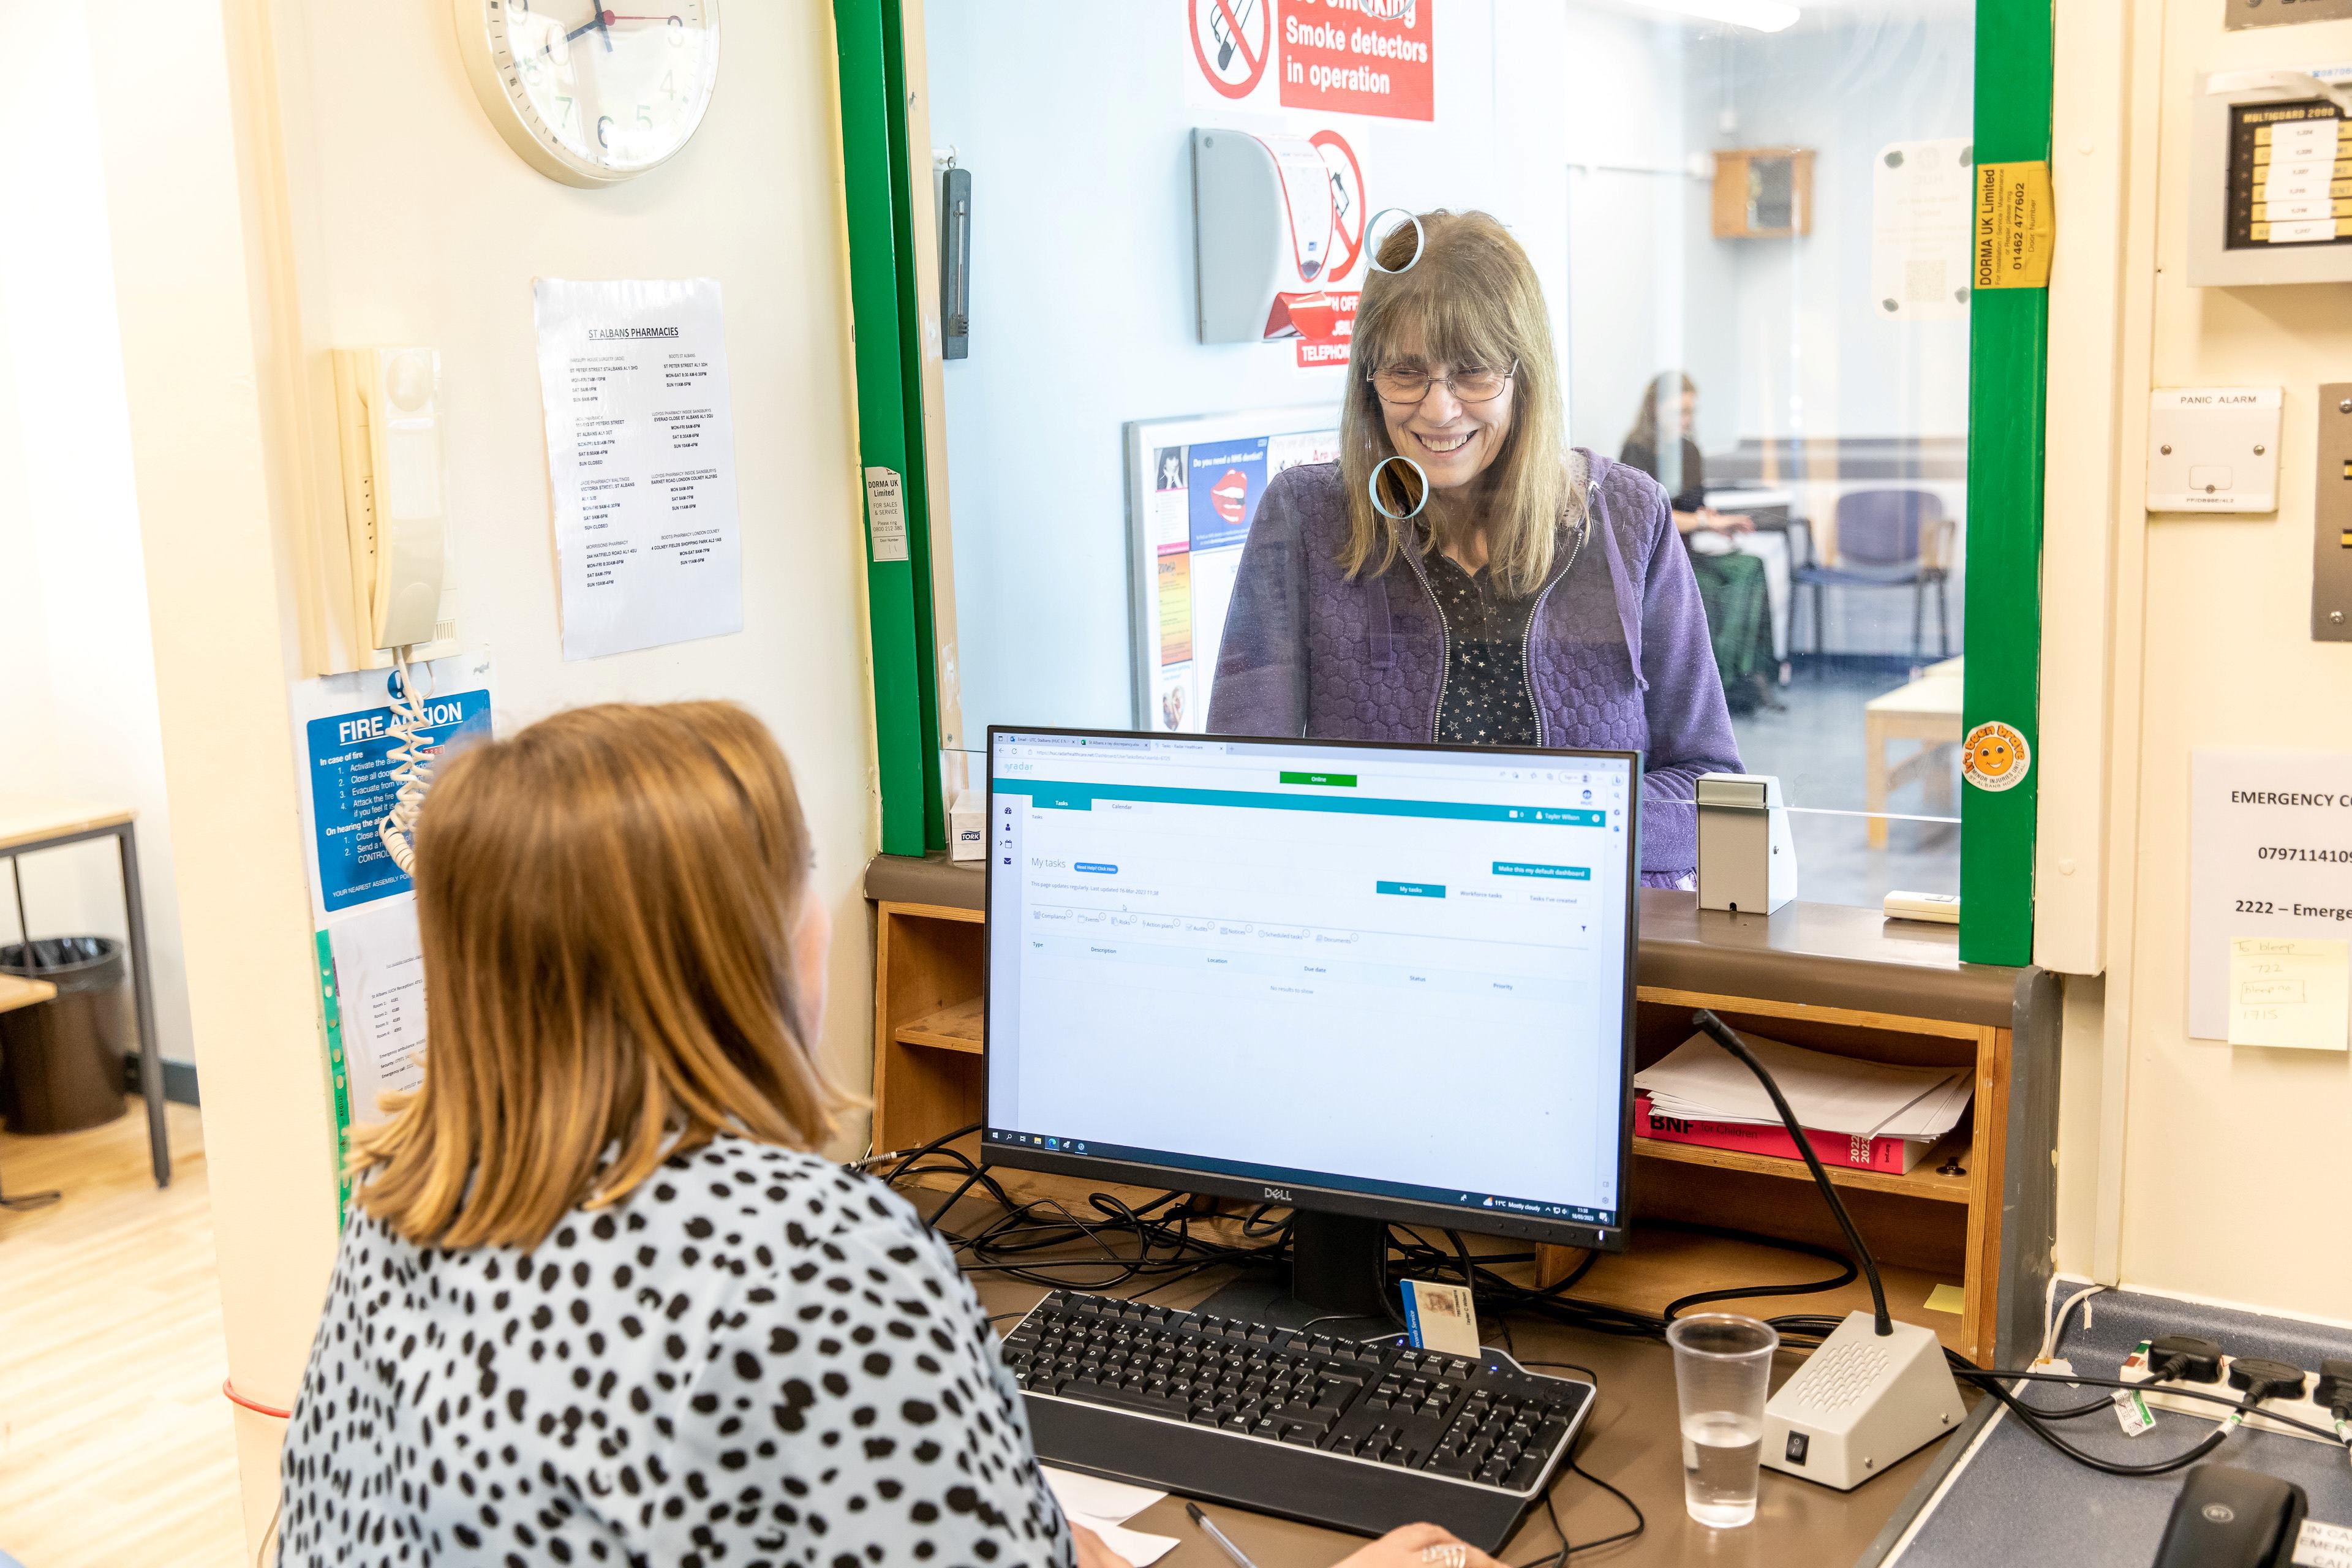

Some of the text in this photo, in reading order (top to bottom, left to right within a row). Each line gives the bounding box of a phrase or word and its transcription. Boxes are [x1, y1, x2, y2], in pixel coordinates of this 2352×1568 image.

[1286, 15, 1428, 64] Smoke detectors
[1287, 55, 1390, 94] in operation
[660, 70, 677, 100] 4
[555, 96, 573, 128] 7
[1980, 169, 1995, 285] DORMA UK Limited
[2013, 183, 2024, 270] 01462 477602
[589, 327, 679, 338] ST ALBANS PHARMACIES
[1193, 459, 1201, 467] Do
[1202, 459, 1212, 468] you
[1213, 455, 1226, 466] need
[1231, 453, 1242, 463] NHS
[1243, 451, 1263, 462] dentist?
[339, 717, 383, 742] FIRE
[1966, 725, 2024, 760] been brave
[350, 763, 374, 772] Activate
[1009, 761, 1033, 771] radar
[351, 774, 368, 783] Close
[1972, 769, 1989, 782] MINOR
[1989, 774, 2013, 783] INJURIES
[2003, 764, 2025, 786] HOSPITAL
[352, 785, 379, 796] Evacuate
[381, 781, 394, 790] from
[353, 797, 372, 807] Attack
[2231, 791, 2333, 807] EMERGENCY
[337, 823, 361, 833] hearing
[1031, 858, 1066, 868] My tasks
[349, 883, 371, 893] NEAREST
[372, 876, 398, 887] ASSEMBLY
[2236, 900, 2274, 914] 2222
[2233, 940, 2295, 954] To bleep
[379, 1050, 397, 1058] Emergency
[1649, 1115, 1758, 1140] BNF for Children
[1850, 1135, 1860, 1163] 2022
[1861, 1139, 1871, 1164] 2023
[1265, 1188, 1292, 1201] DELL
[1508, 1202, 1524, 1210] Mostly
